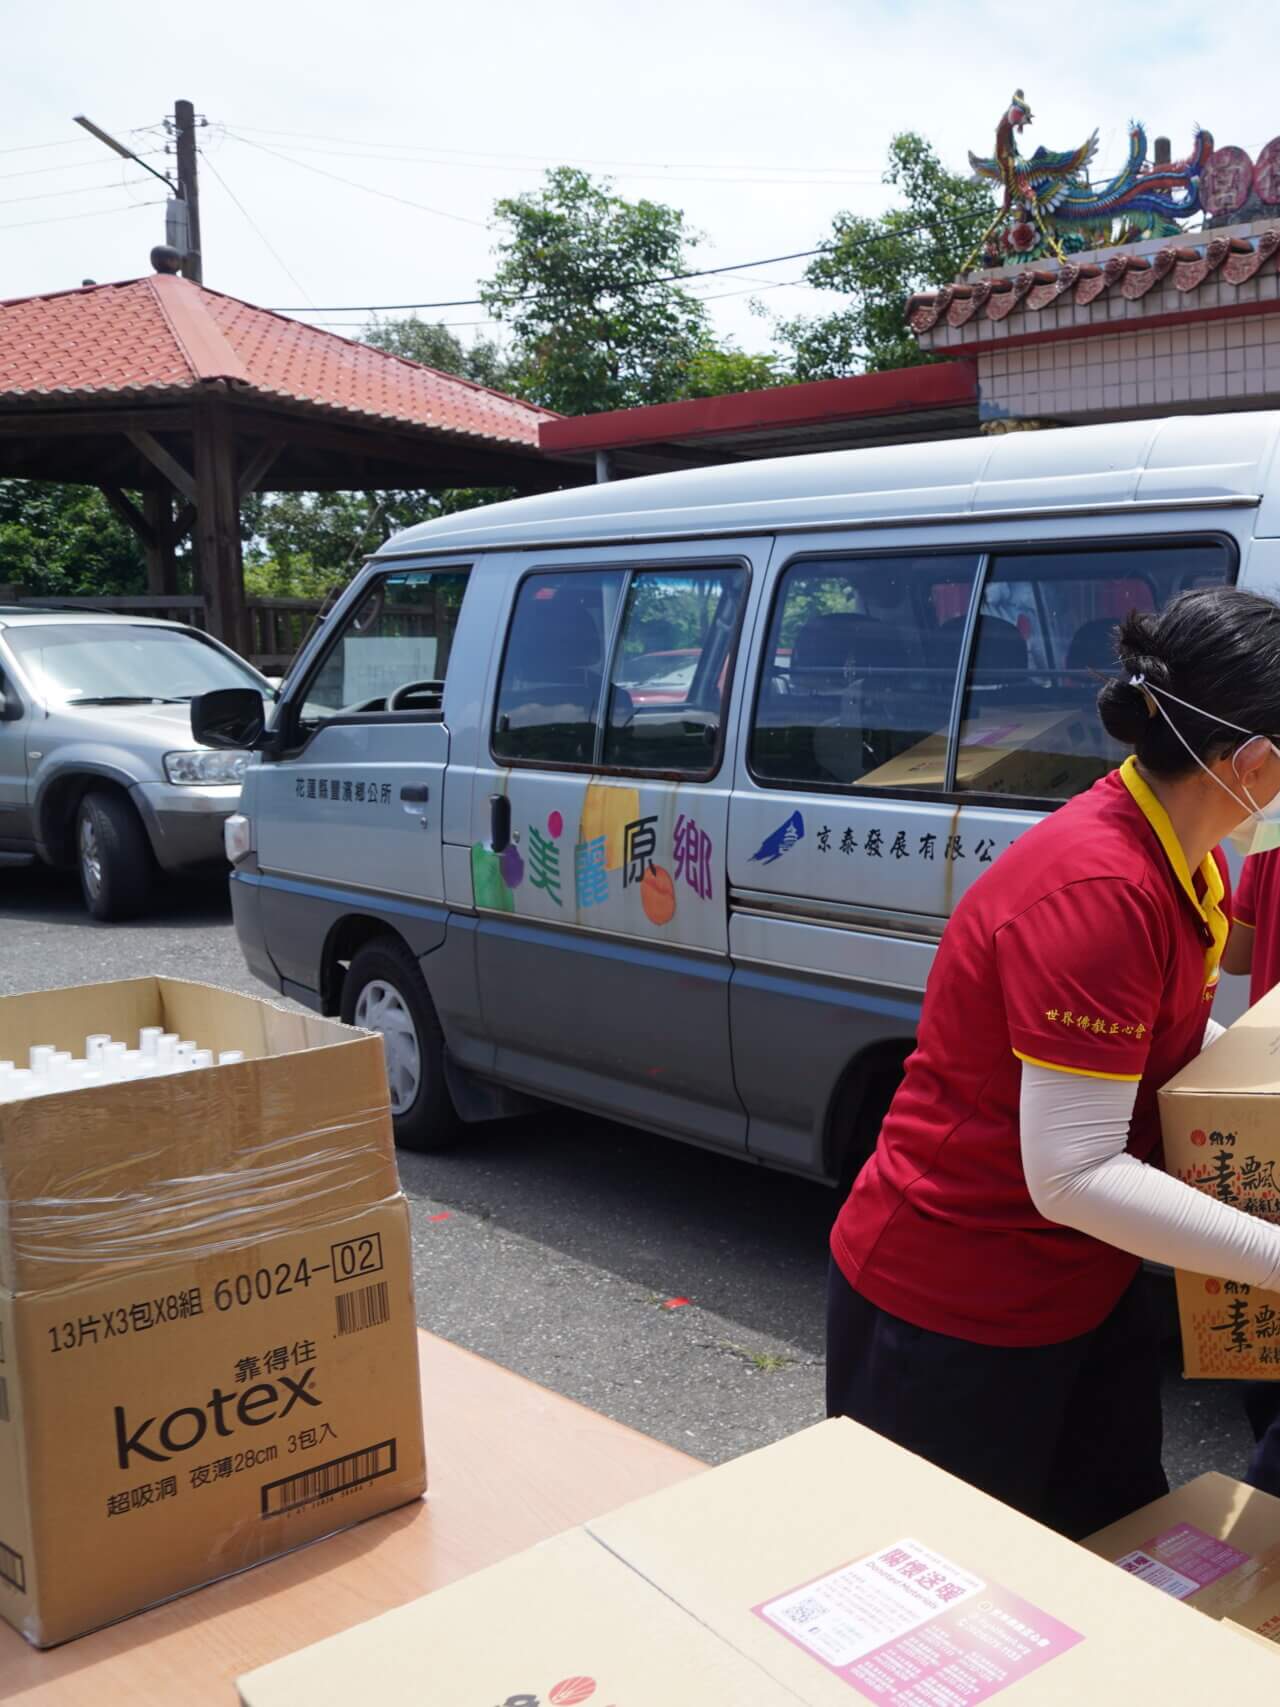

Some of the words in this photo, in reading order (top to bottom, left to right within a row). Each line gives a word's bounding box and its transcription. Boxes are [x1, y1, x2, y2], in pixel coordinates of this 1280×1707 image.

[529, 813, 713, 908] 美麗原鄉
[816, 825, 1015, 862] 京泰發展有限公
[1045, 1009, 1147, 1040] 世界佛教正心會
[48, 1287, 204, 1353] 13片X3包X8組
[234, 1340, 317, 1383] 靠得住
[114, 1367, 322, 1470] kotex
[106, 1475, 178, 1518] 超吸洞
[189, 1444, 278, 1489] 夜薄28cm
[287, 1422, 338, 1454] 3包入
